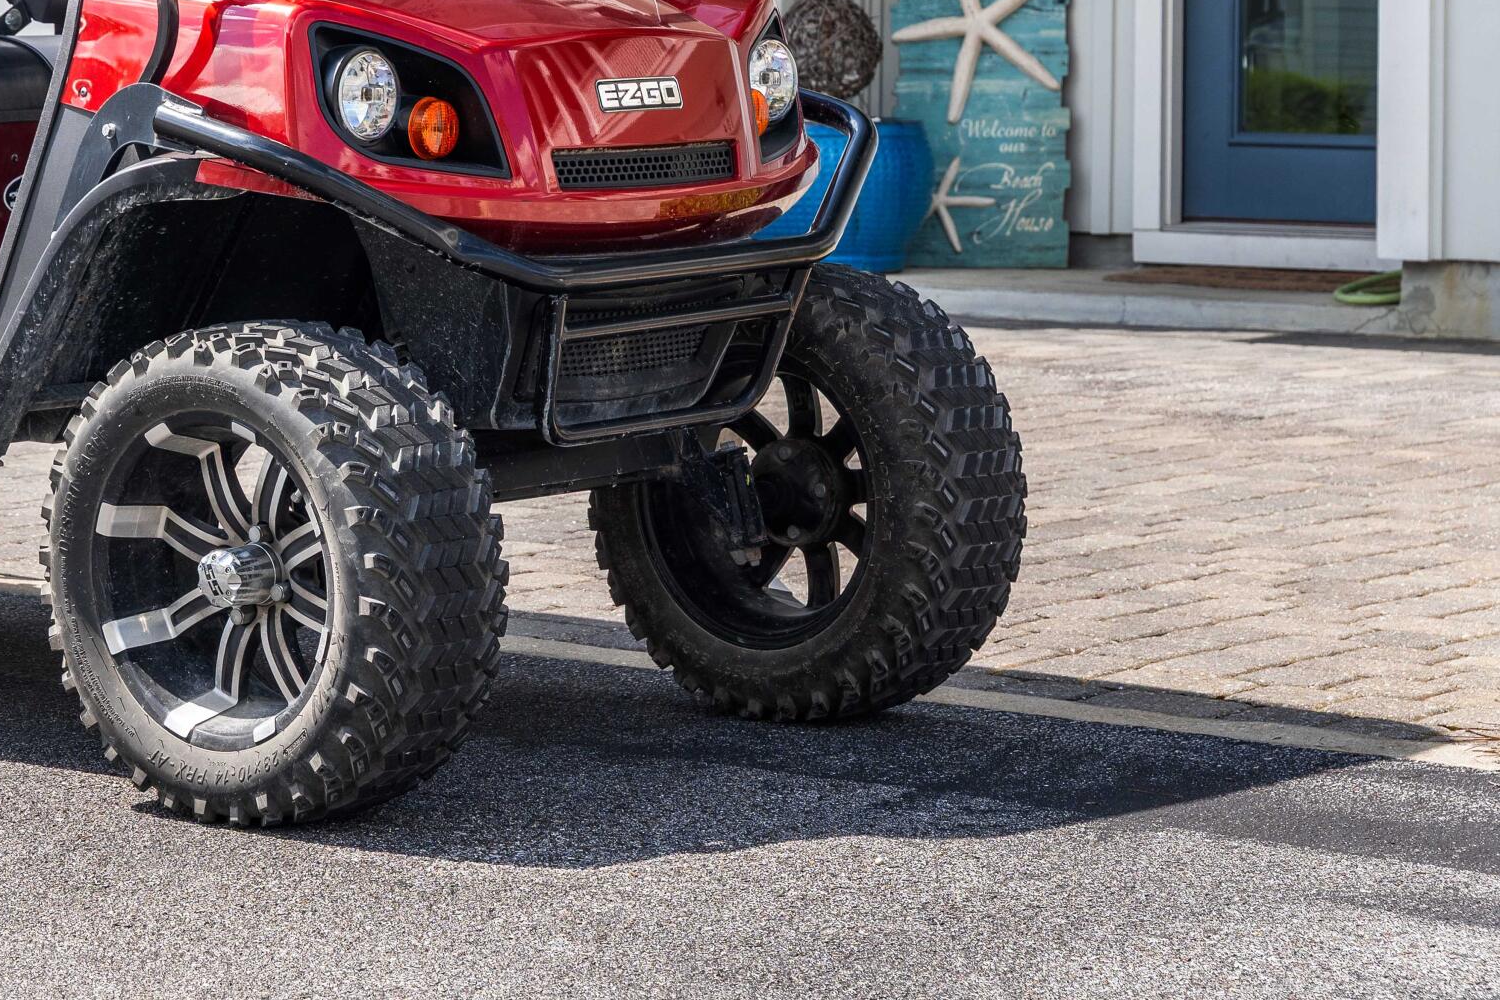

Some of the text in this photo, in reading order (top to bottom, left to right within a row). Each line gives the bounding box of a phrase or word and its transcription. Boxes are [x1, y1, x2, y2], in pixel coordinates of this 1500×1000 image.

[960, 117, 1058, 138] Welcome to
[999, 141, 1028, 153] our
[954, 161, 1056, 193] Beach
[972, 188, 1054, 245] House
